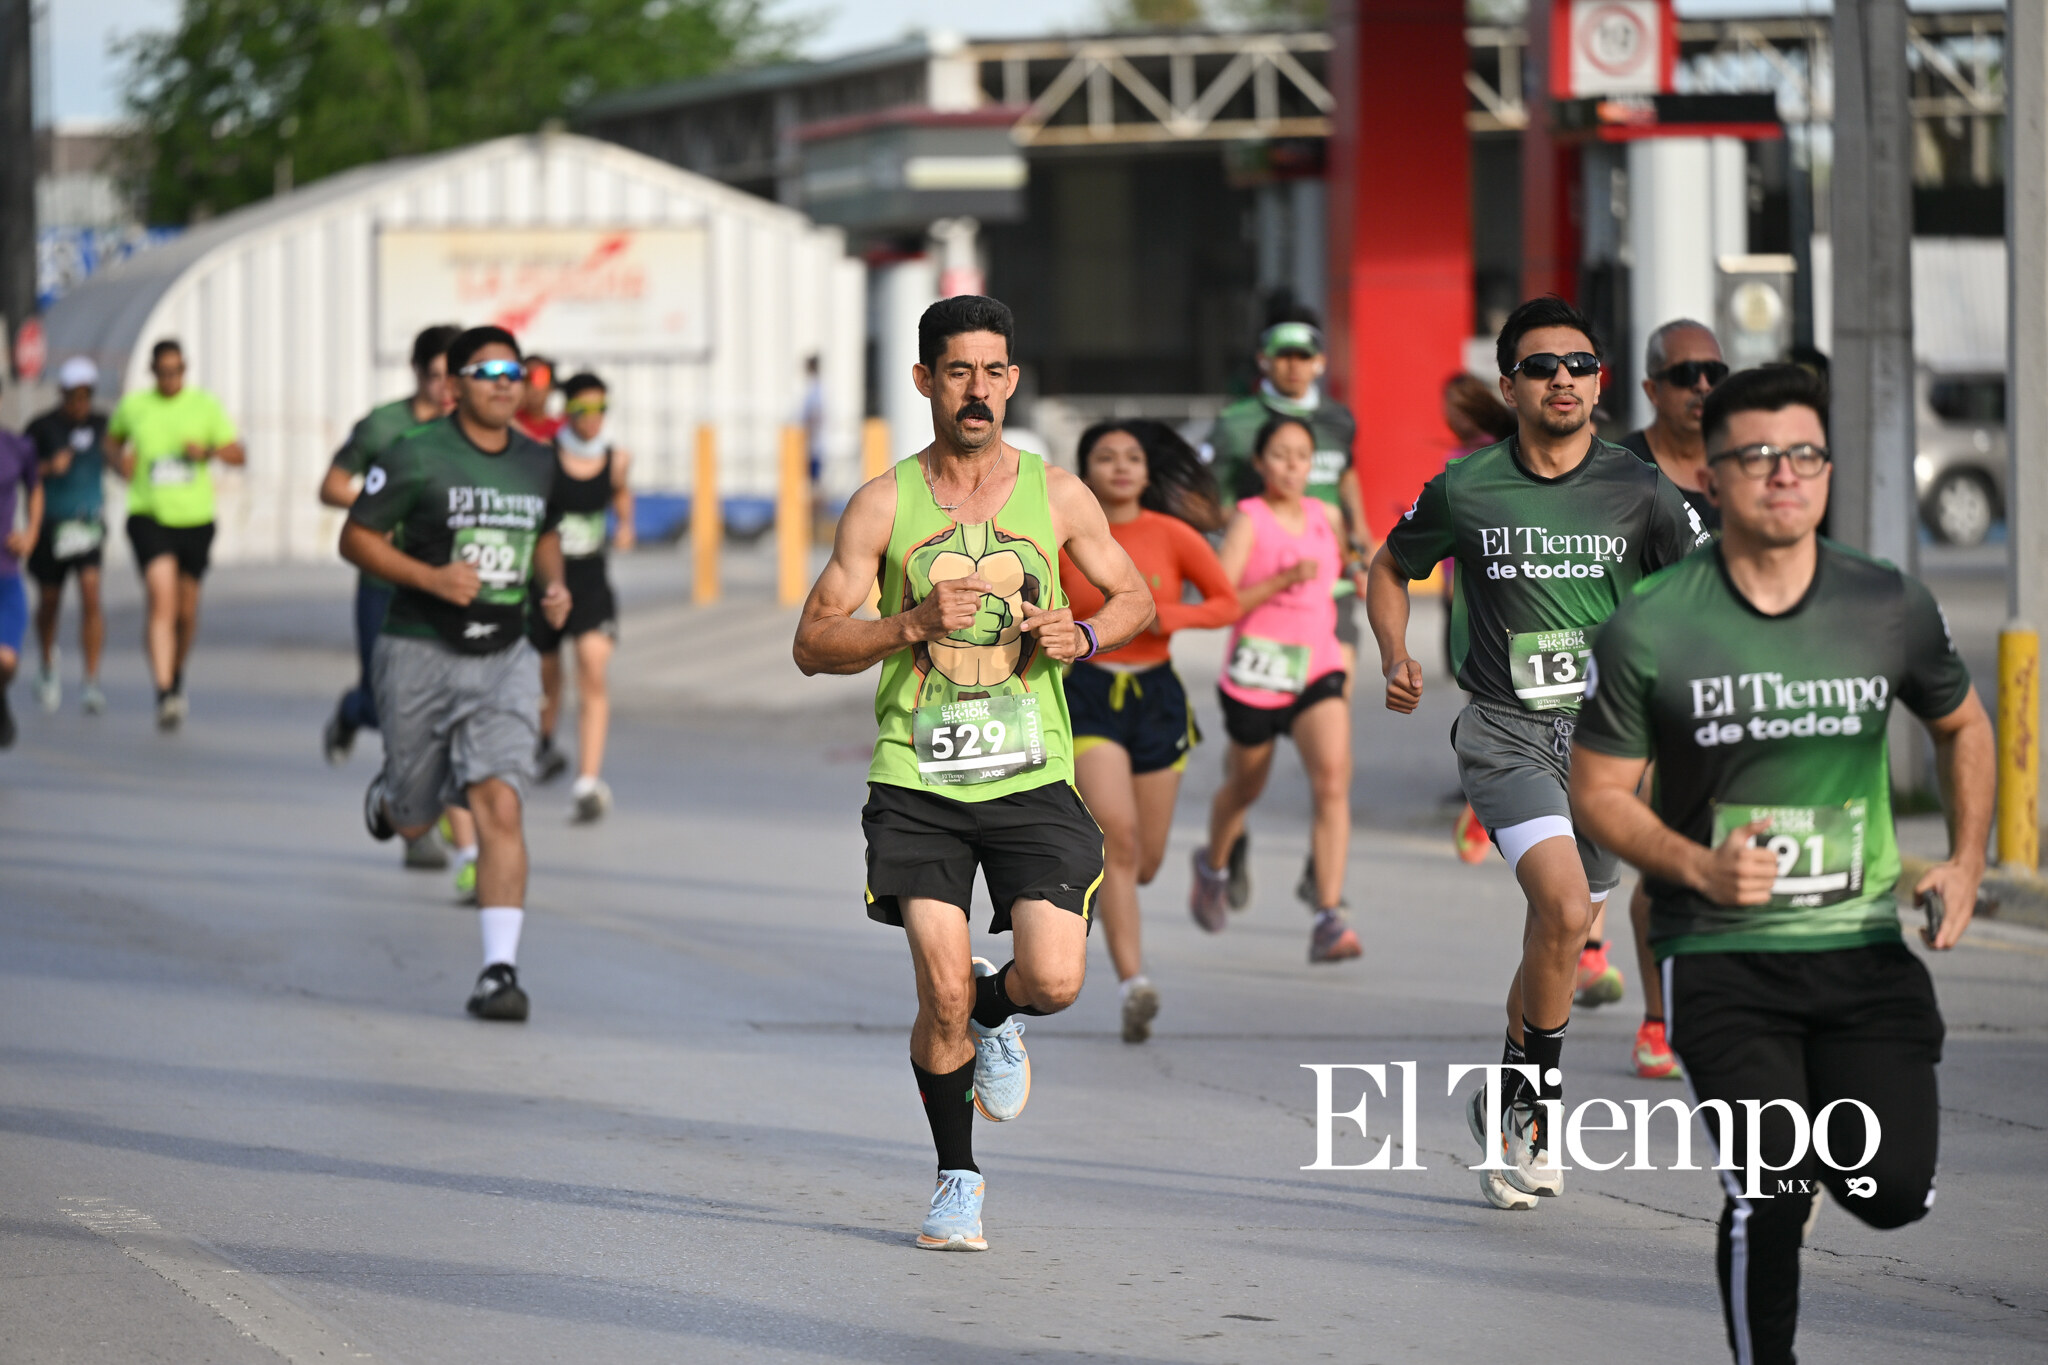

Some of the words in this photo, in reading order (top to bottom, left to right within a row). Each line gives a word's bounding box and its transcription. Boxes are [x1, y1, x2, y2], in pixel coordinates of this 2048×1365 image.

[1478, 526, 1512, 557] El
[1515, 526, 1627, 563] Tiempo
[1486, 561, 1517, 580] de
[1521, 559, 1605, 579] todos
[1537, 630, 1585, 640] CARRERA
[940, 700, 989, 712] CARRERA
[1021, 697, 1036, 706] 529
[1689, 675, 1736, 719] El
[1738, 671, 1890, 713] Tiempo
[931, 720, 1006, 760] 529
[1025, 710, 1042, 765] MEDALLA
[1695, 721, 1744, 747] de
[1747, 711, 1862, 741] todos
